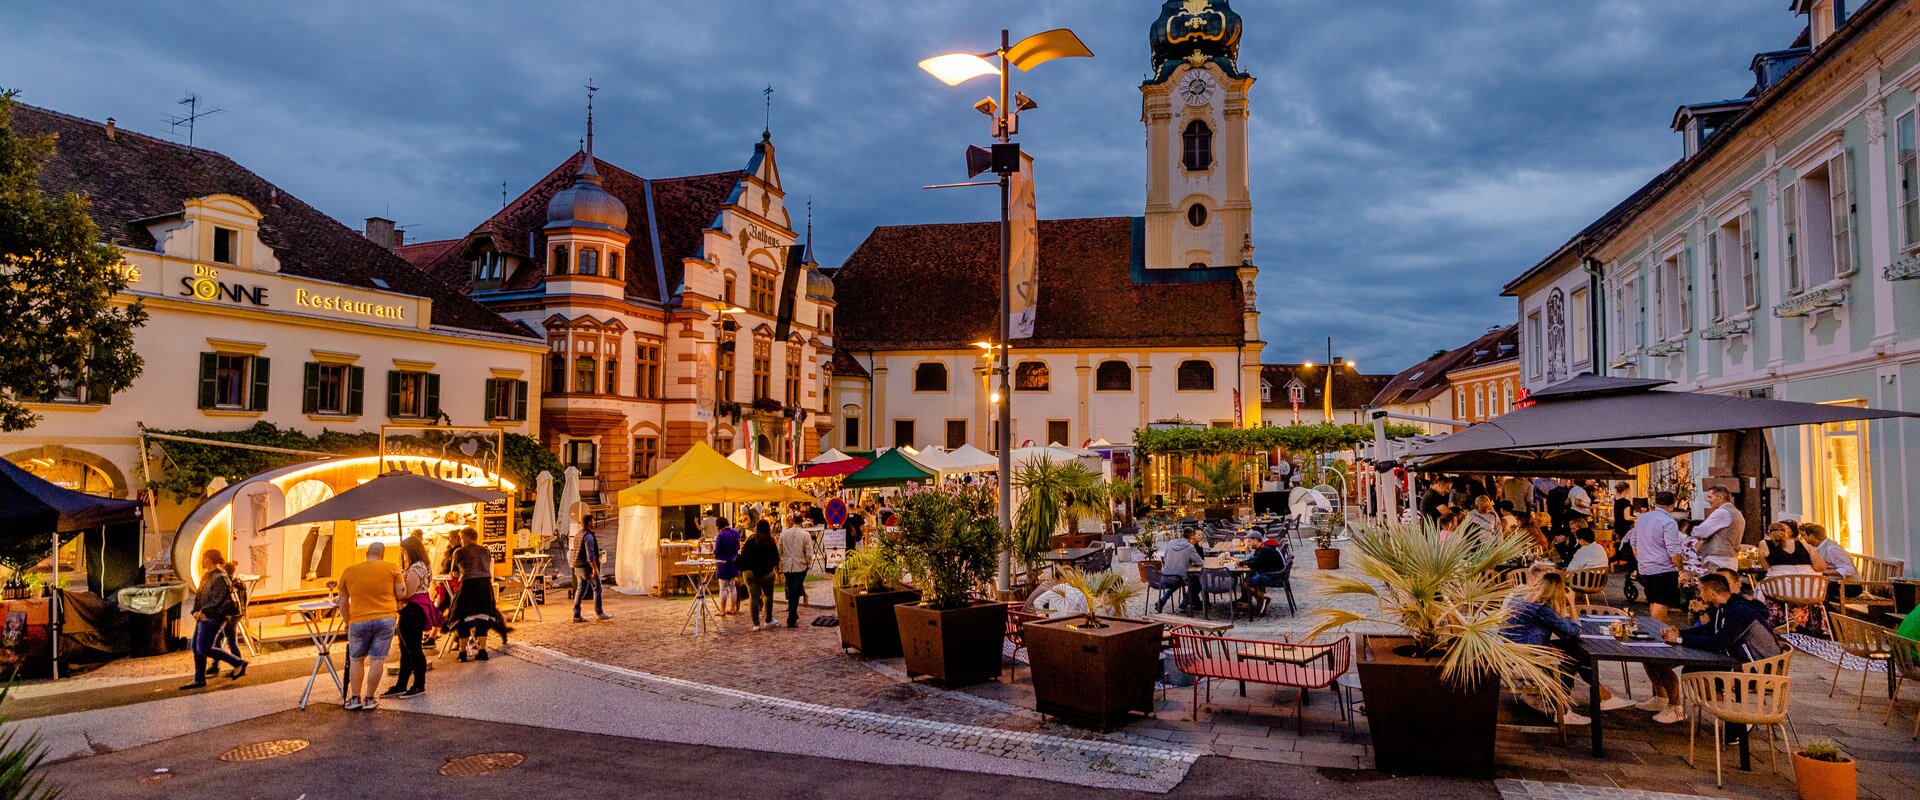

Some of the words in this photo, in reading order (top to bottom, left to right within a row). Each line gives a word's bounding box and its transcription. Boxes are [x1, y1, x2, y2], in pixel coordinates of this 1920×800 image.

[193, 264, 219, 278] Die
[180, 276, 270, 307] SONNE
[296, 287, 405, 320] Restaurant
